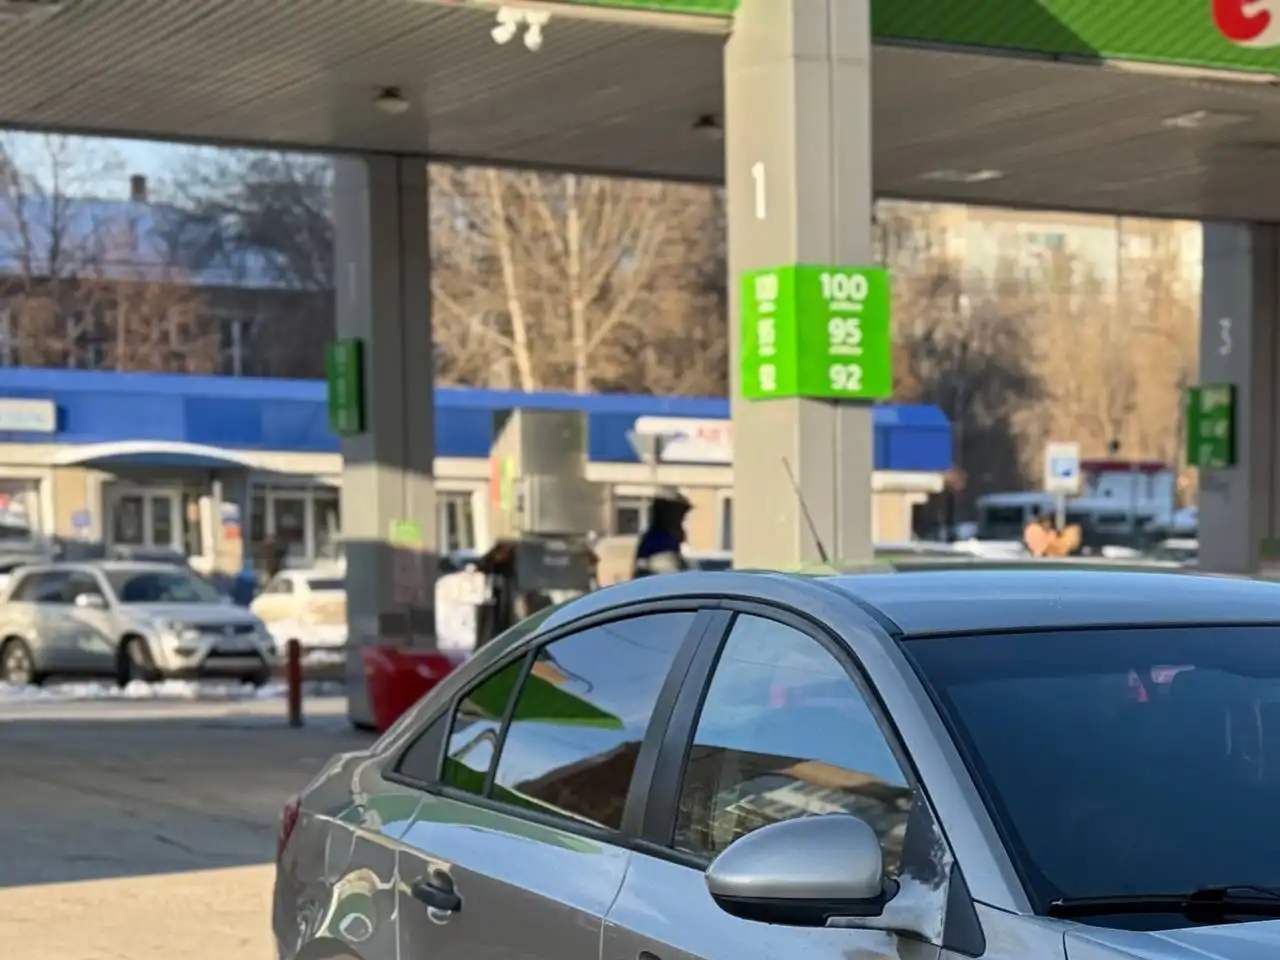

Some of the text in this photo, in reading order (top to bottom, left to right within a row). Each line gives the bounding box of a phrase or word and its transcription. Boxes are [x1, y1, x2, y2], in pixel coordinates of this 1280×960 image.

[752, 161, 767, 219] 1
[819, 273, 869, 300] 100
[827, 316, 863, 344] 95
[828, 363, 864, 391] 92
